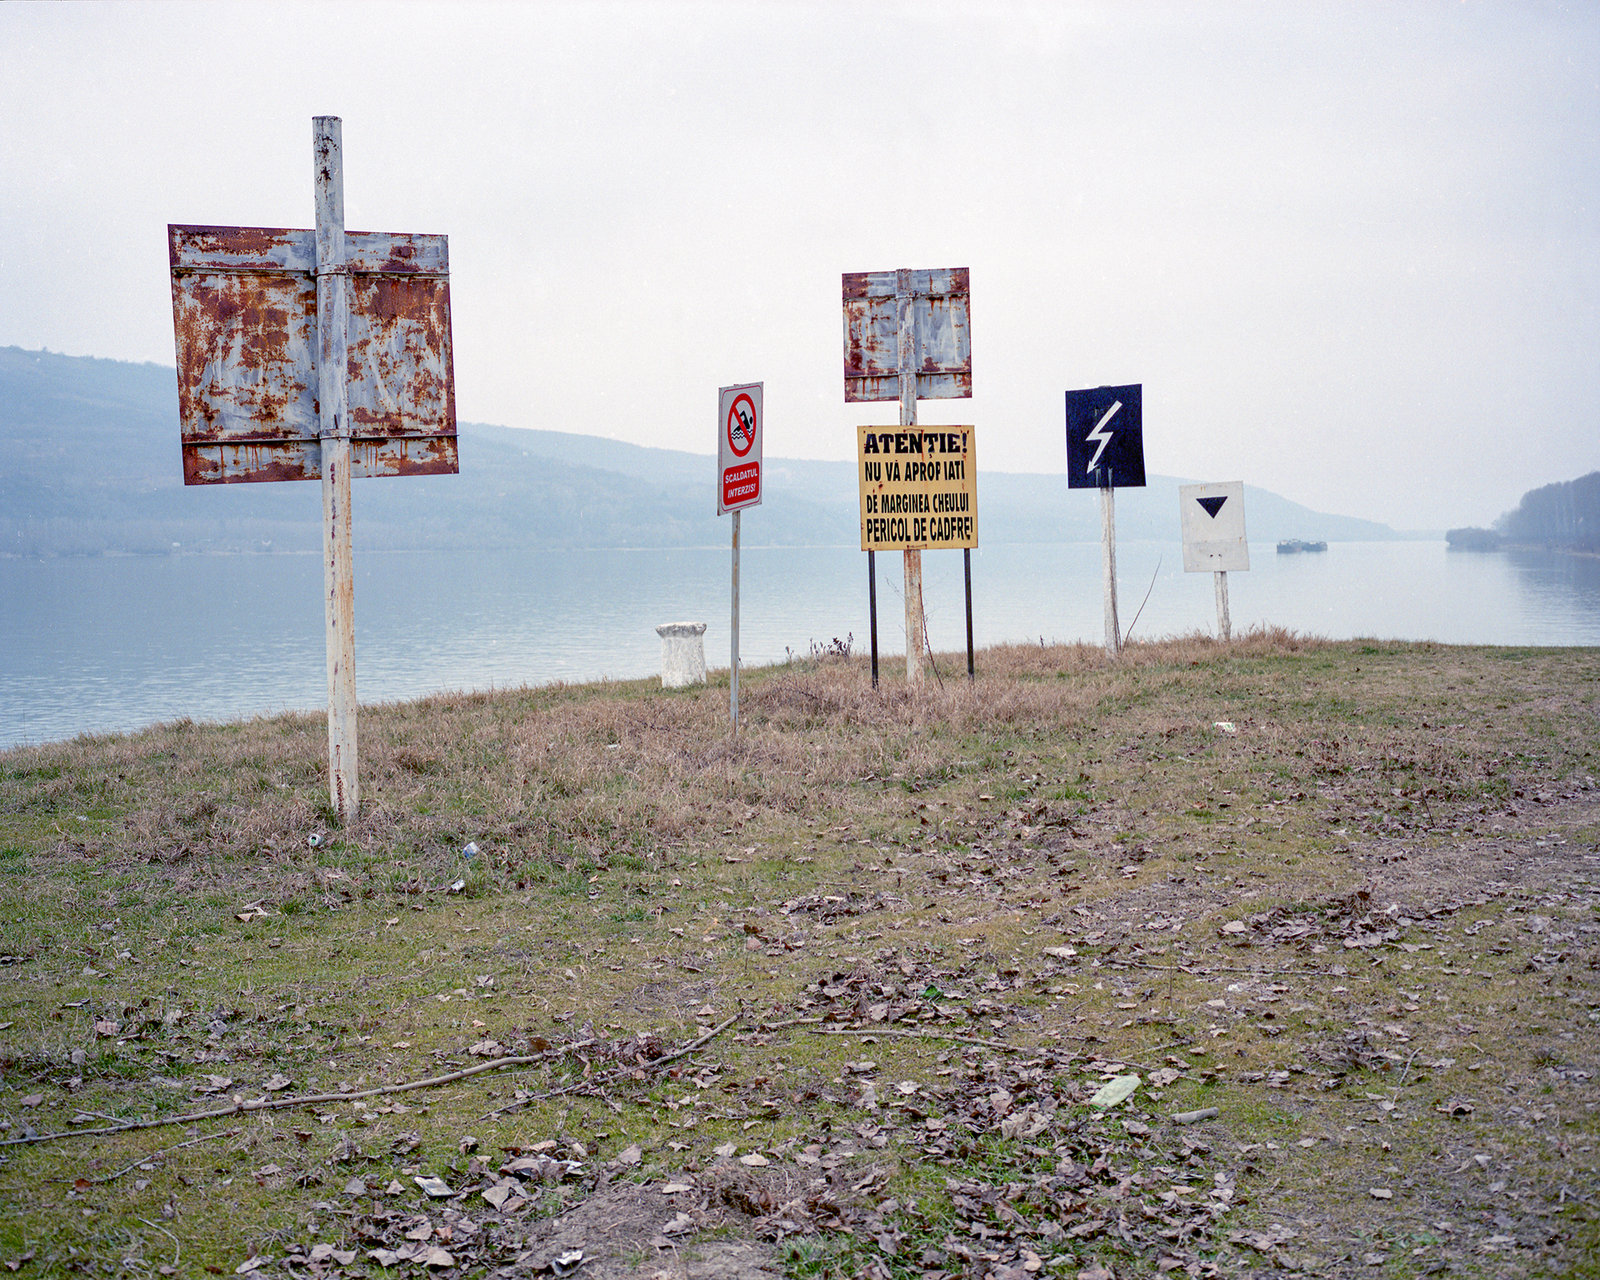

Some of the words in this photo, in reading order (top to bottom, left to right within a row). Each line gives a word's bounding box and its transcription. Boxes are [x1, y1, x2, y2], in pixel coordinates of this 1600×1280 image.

[725, 468, 758, 484] SCALDATUL
[865, 461, 882, 481] NU
[866, 494, 878, 513] DE
[881, 493, 930, 513] MARGINEA
[932, 492, 969, 513] CHEULUI
[866, 517, 911, 542] PERICOL
[913, 517, 927, 541] DE
